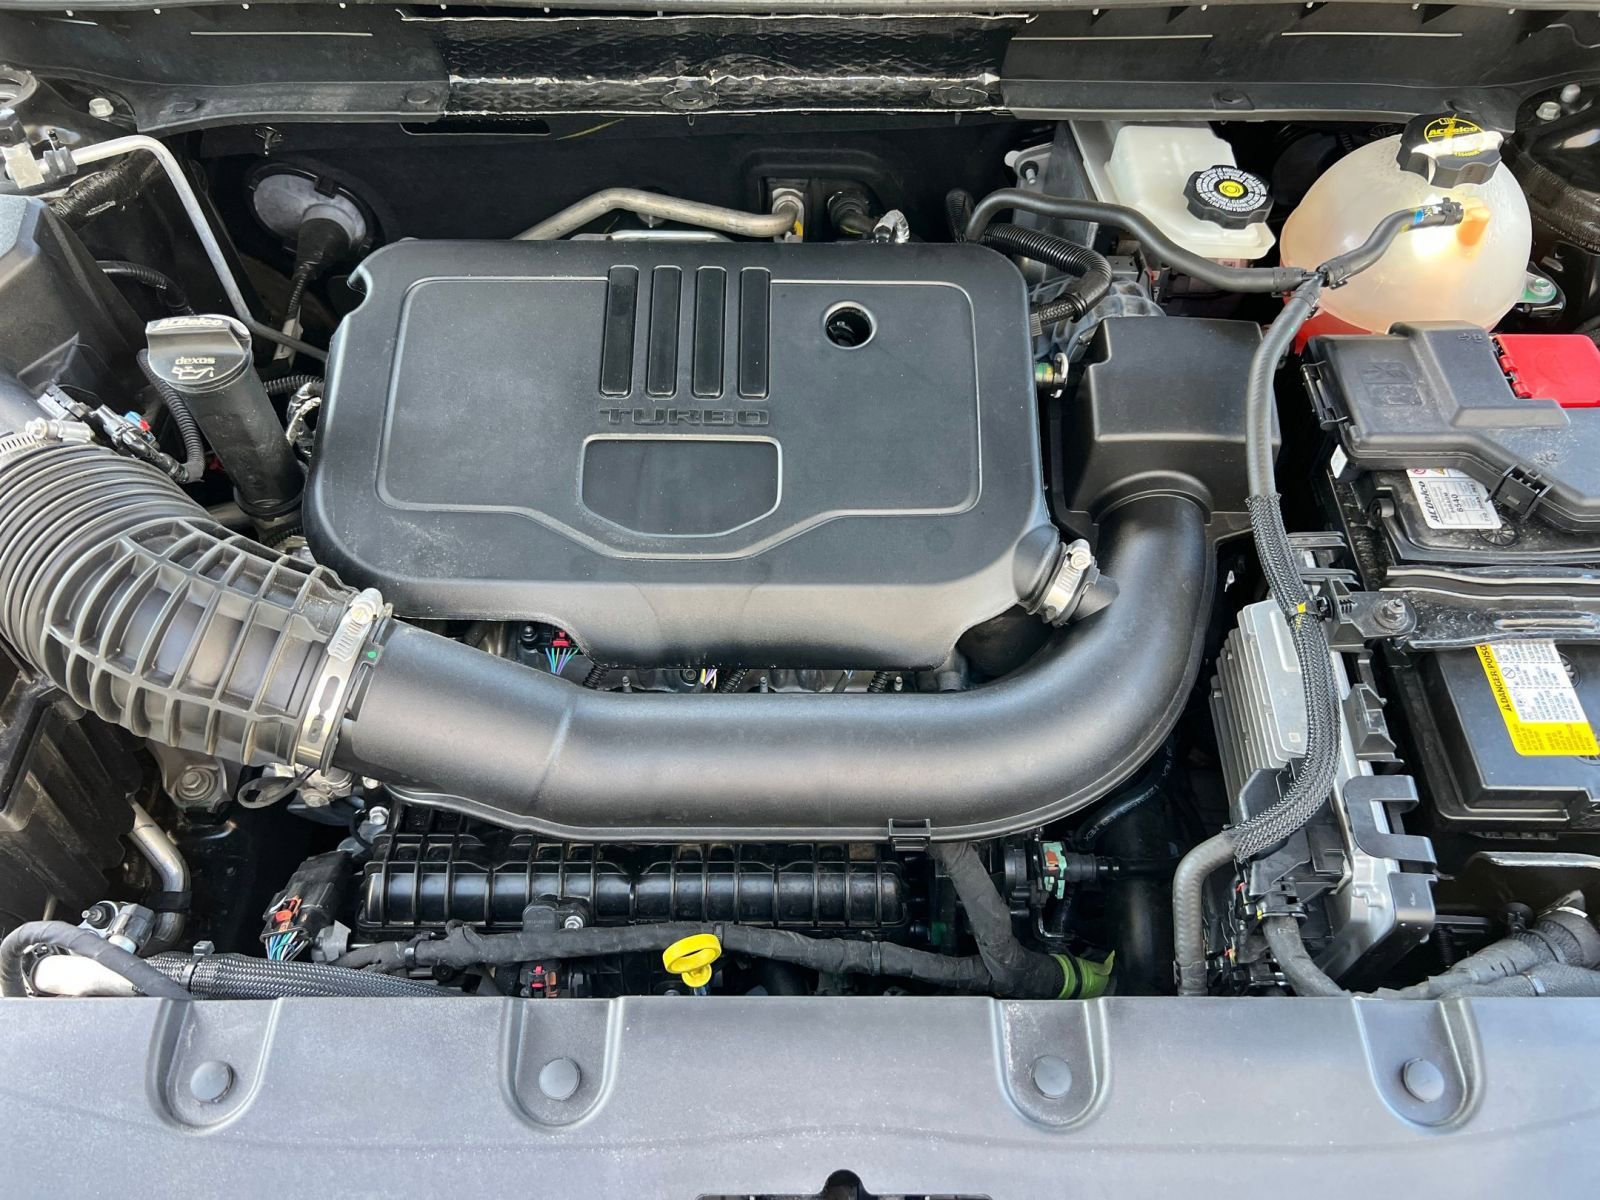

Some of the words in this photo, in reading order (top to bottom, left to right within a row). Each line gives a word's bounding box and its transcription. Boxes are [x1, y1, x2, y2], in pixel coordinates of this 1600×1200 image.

[1428, 126, 1479, 136] ACelco
[175, 356, 216, 365] dexos
[599, 408, 769, 425] TURBO
[1418, 480, 1441, 522] ACDelco
